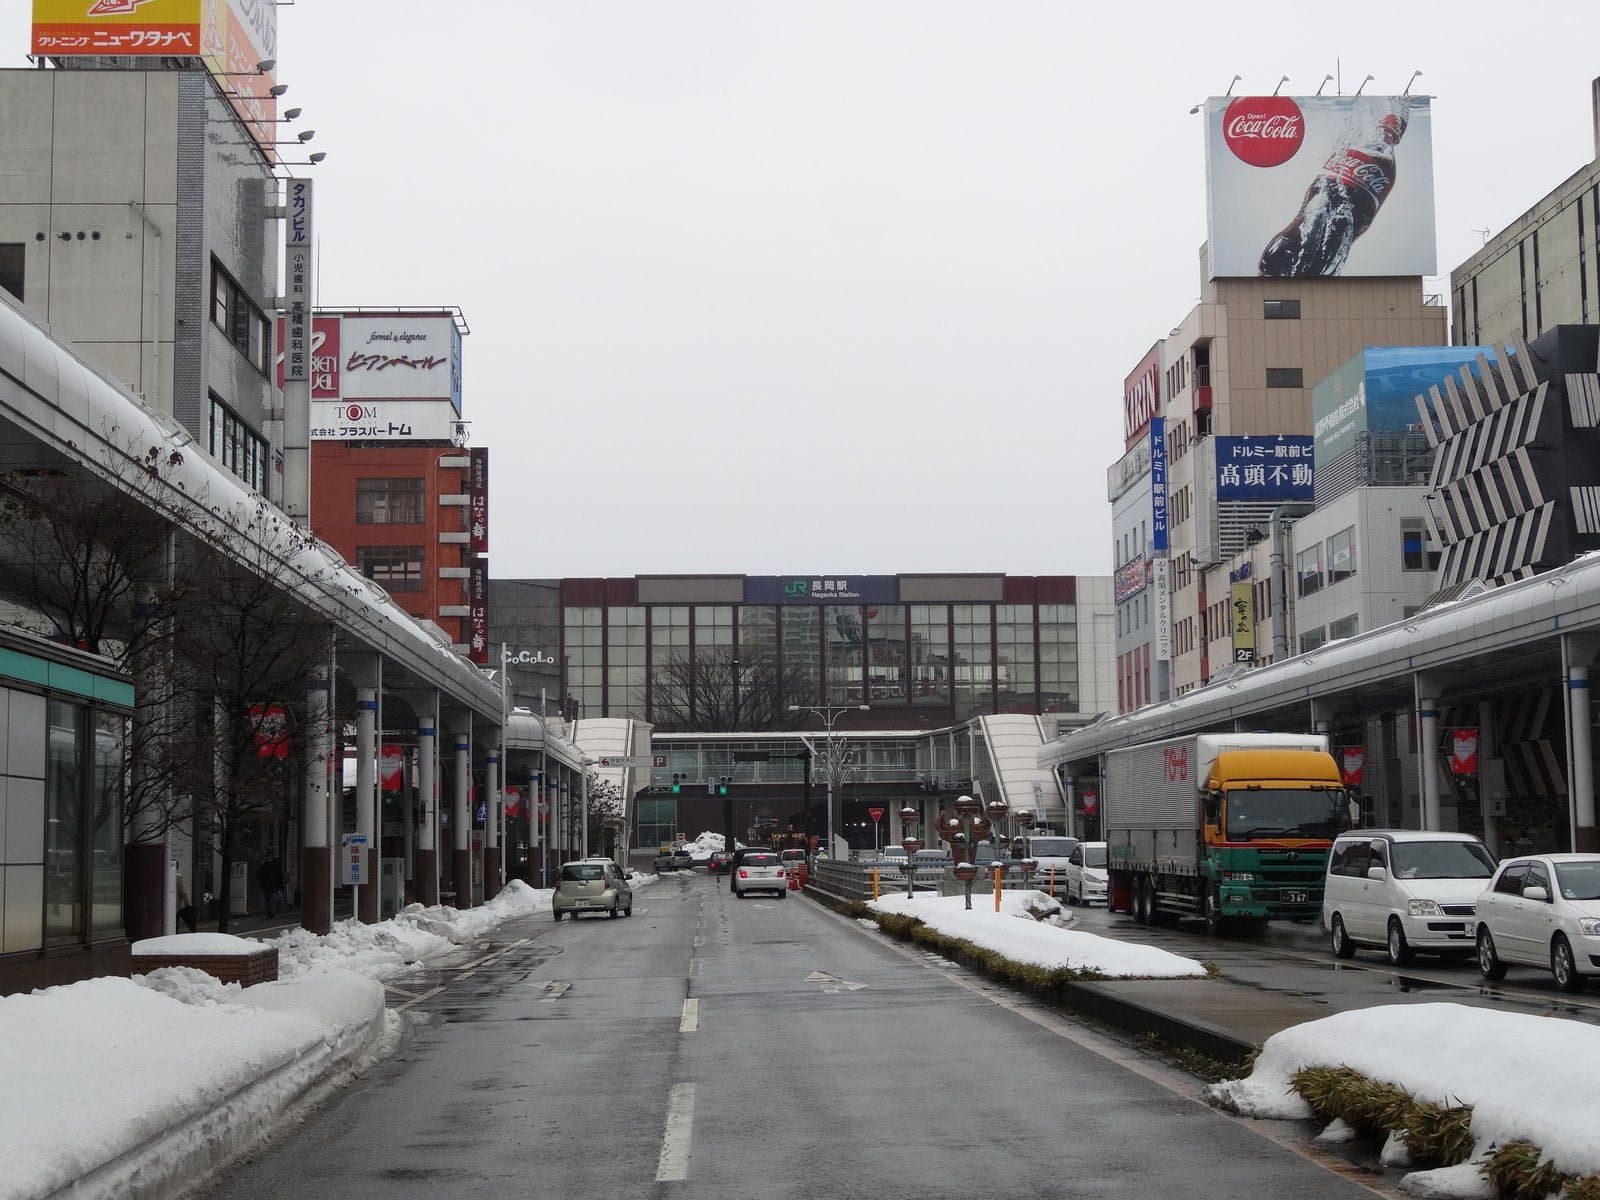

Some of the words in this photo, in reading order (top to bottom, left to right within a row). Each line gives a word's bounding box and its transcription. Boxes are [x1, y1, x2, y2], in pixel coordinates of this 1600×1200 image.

[38, 37, 90, 46] クリーニング
[93, 31, 192, 47] ニューワタナベ
[1228, 115, 1301, 138] Coca-Cola
[292, 183, 305, 242] タカノビル
[293, 253, 304, 293] 小児歯科
[291, 301, 303, 376] 高橋歯科医院
[347, 350, 447, 371] ビアンベール
[1126, 364, 1156, 438] KIRIN
[1233, 445, 1313, 458] ドルミー駅前ビ
[1153, 436, 1166, 531] ドルミー駅前ビル
[784, 581, 807, 593] JR
[812, 581, 847, 591] 長岡駅
[1237, 650, 1252, 661] 2F
